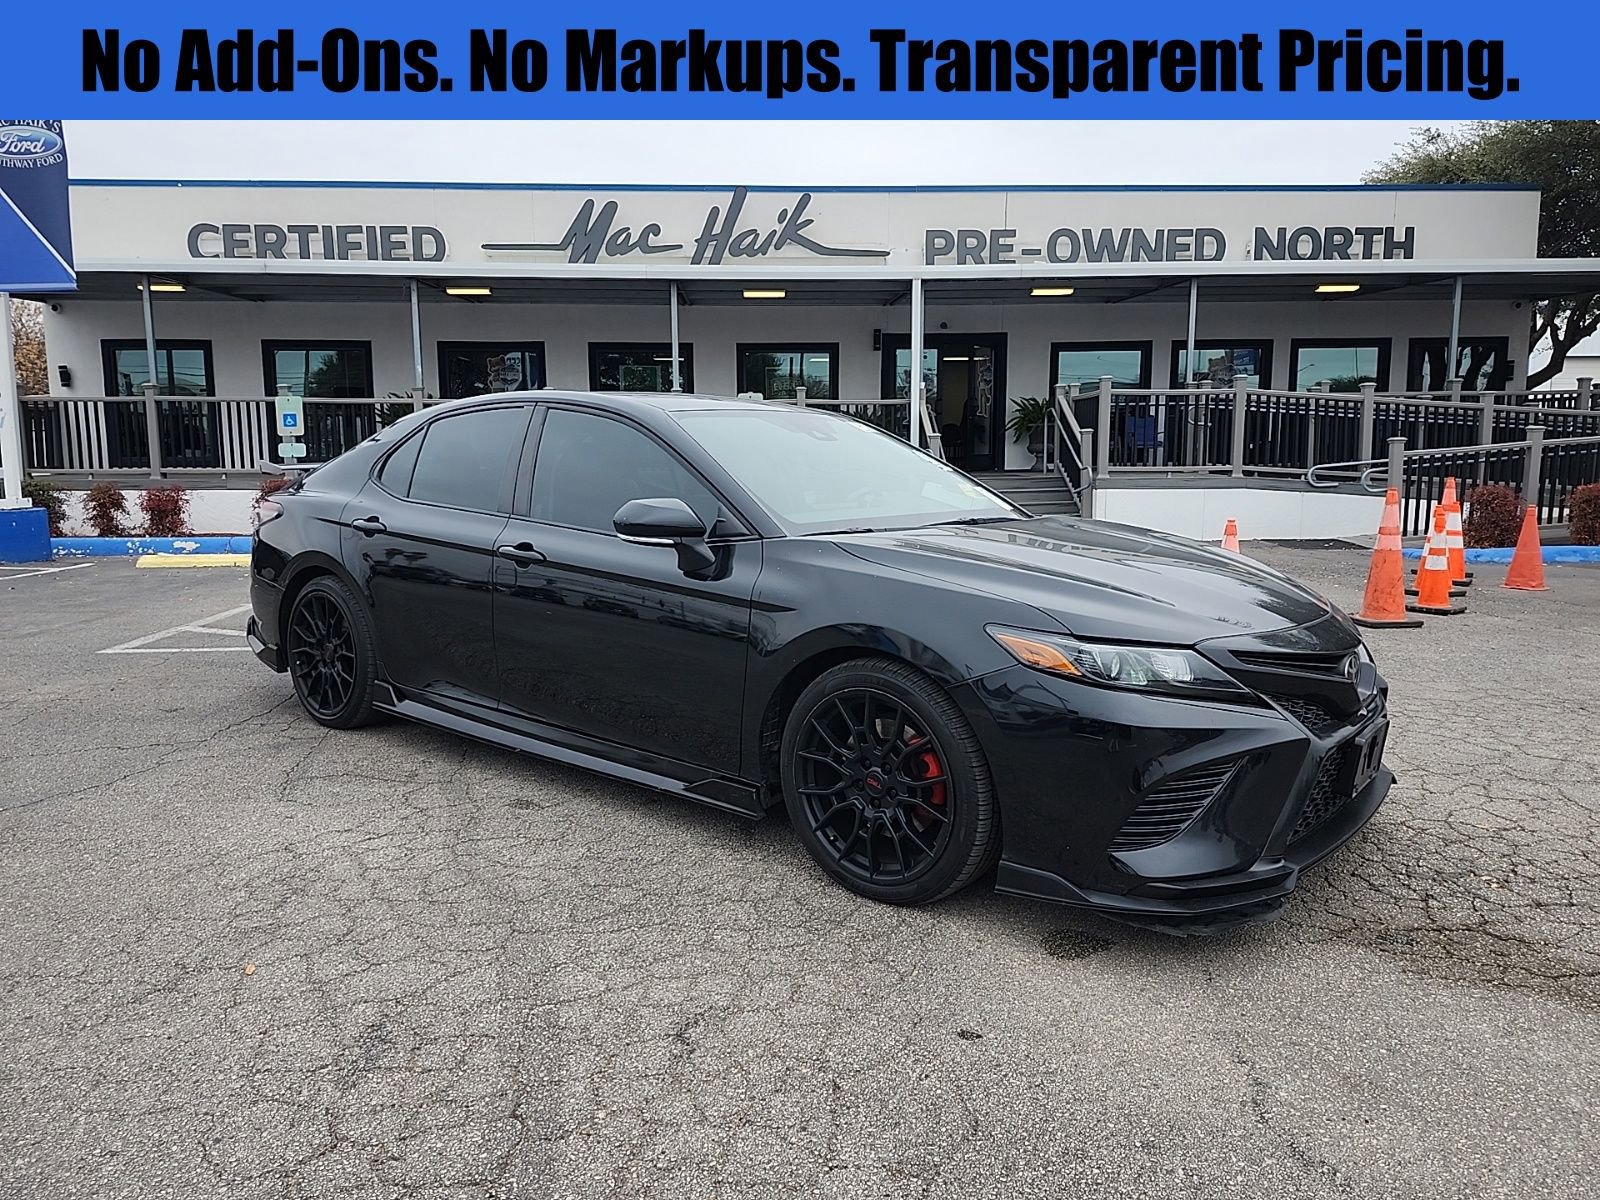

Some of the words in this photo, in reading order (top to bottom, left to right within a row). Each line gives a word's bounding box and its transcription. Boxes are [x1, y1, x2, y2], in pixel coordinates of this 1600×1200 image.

[0, 131, 46, 153] Ford
[0, 158, 34, 169] THWAY
[36, 153, 63, 167] FORD
[188, 223, 446, 261] CERTIFIED
[481, 199, 683, 264] Mac
[690, 186, 890, 266] Haik
[926, 228, 1226, 265] PRE-OWNED
[1254, 227, 1415, 260] NORTH
